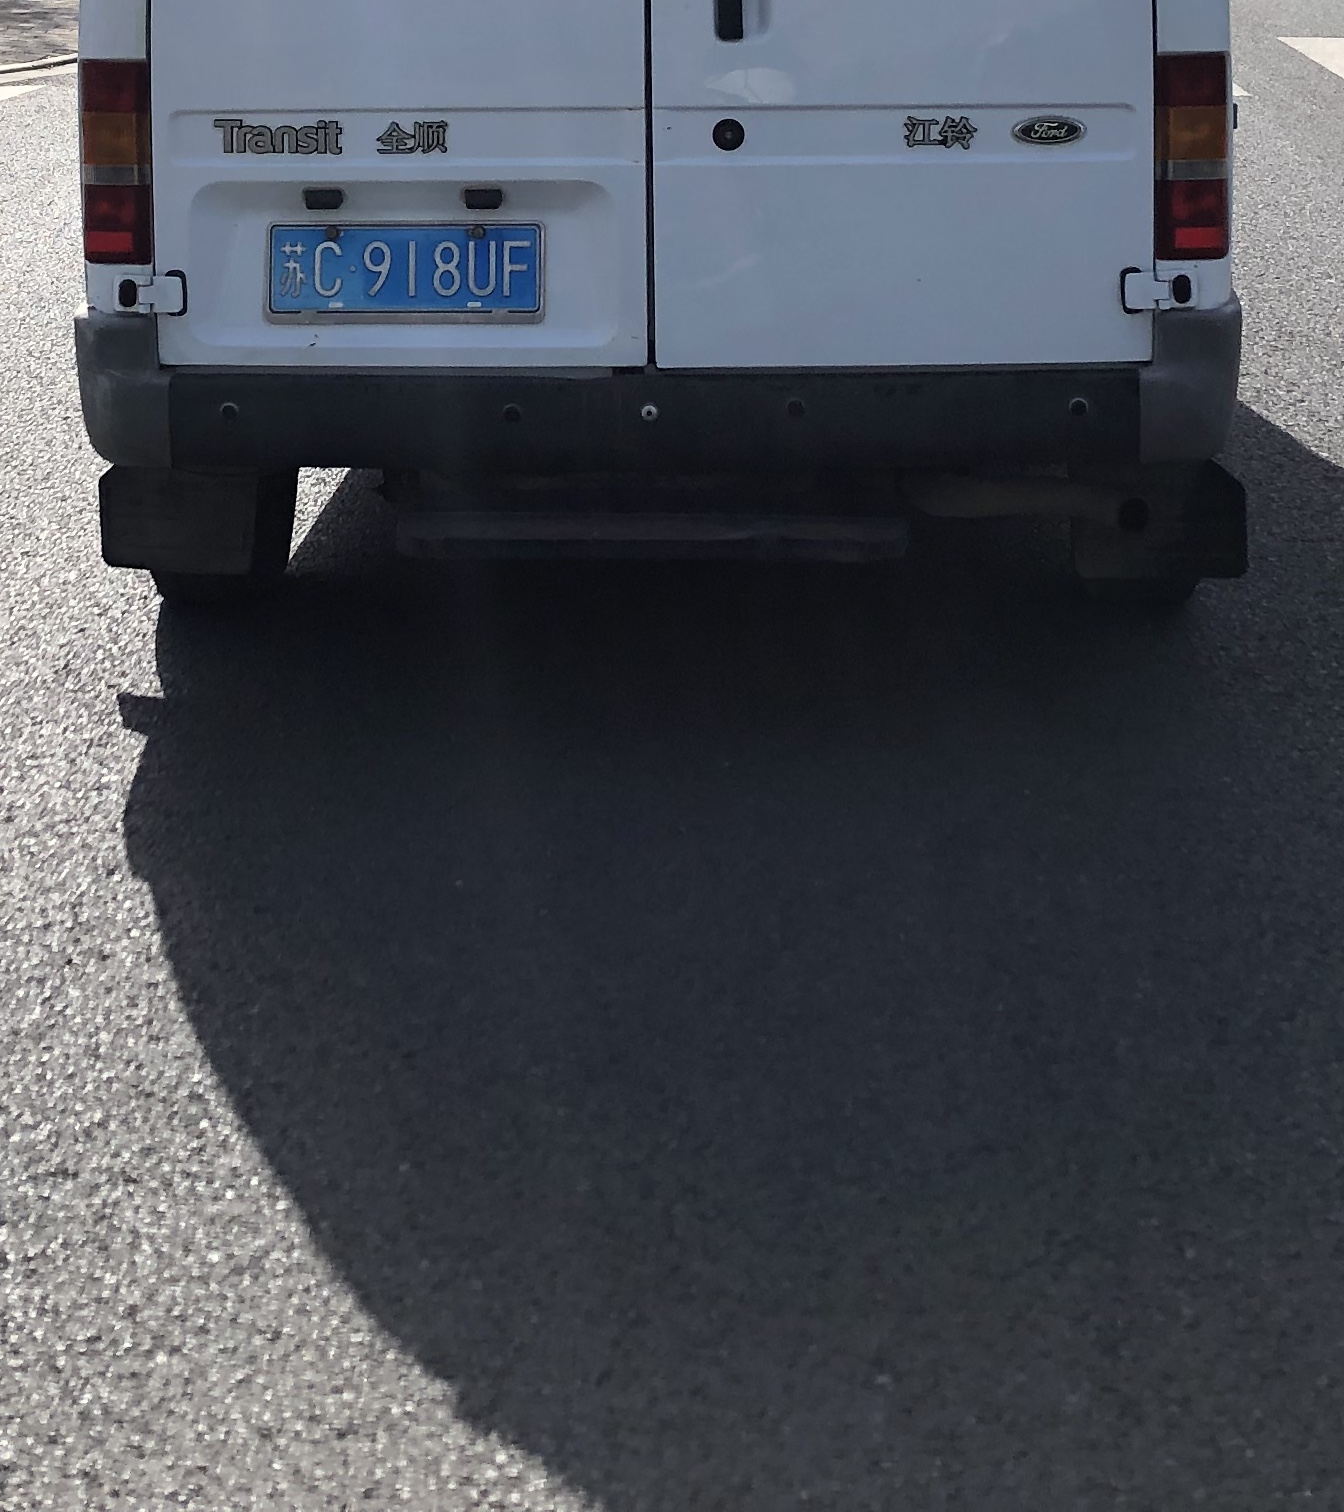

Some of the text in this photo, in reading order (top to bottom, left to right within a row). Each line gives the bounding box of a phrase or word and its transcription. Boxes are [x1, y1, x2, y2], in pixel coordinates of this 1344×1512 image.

[213, 118, 449, 155] Transit 全顺
[903, 115, 1068, 151] 江铃 Ford
